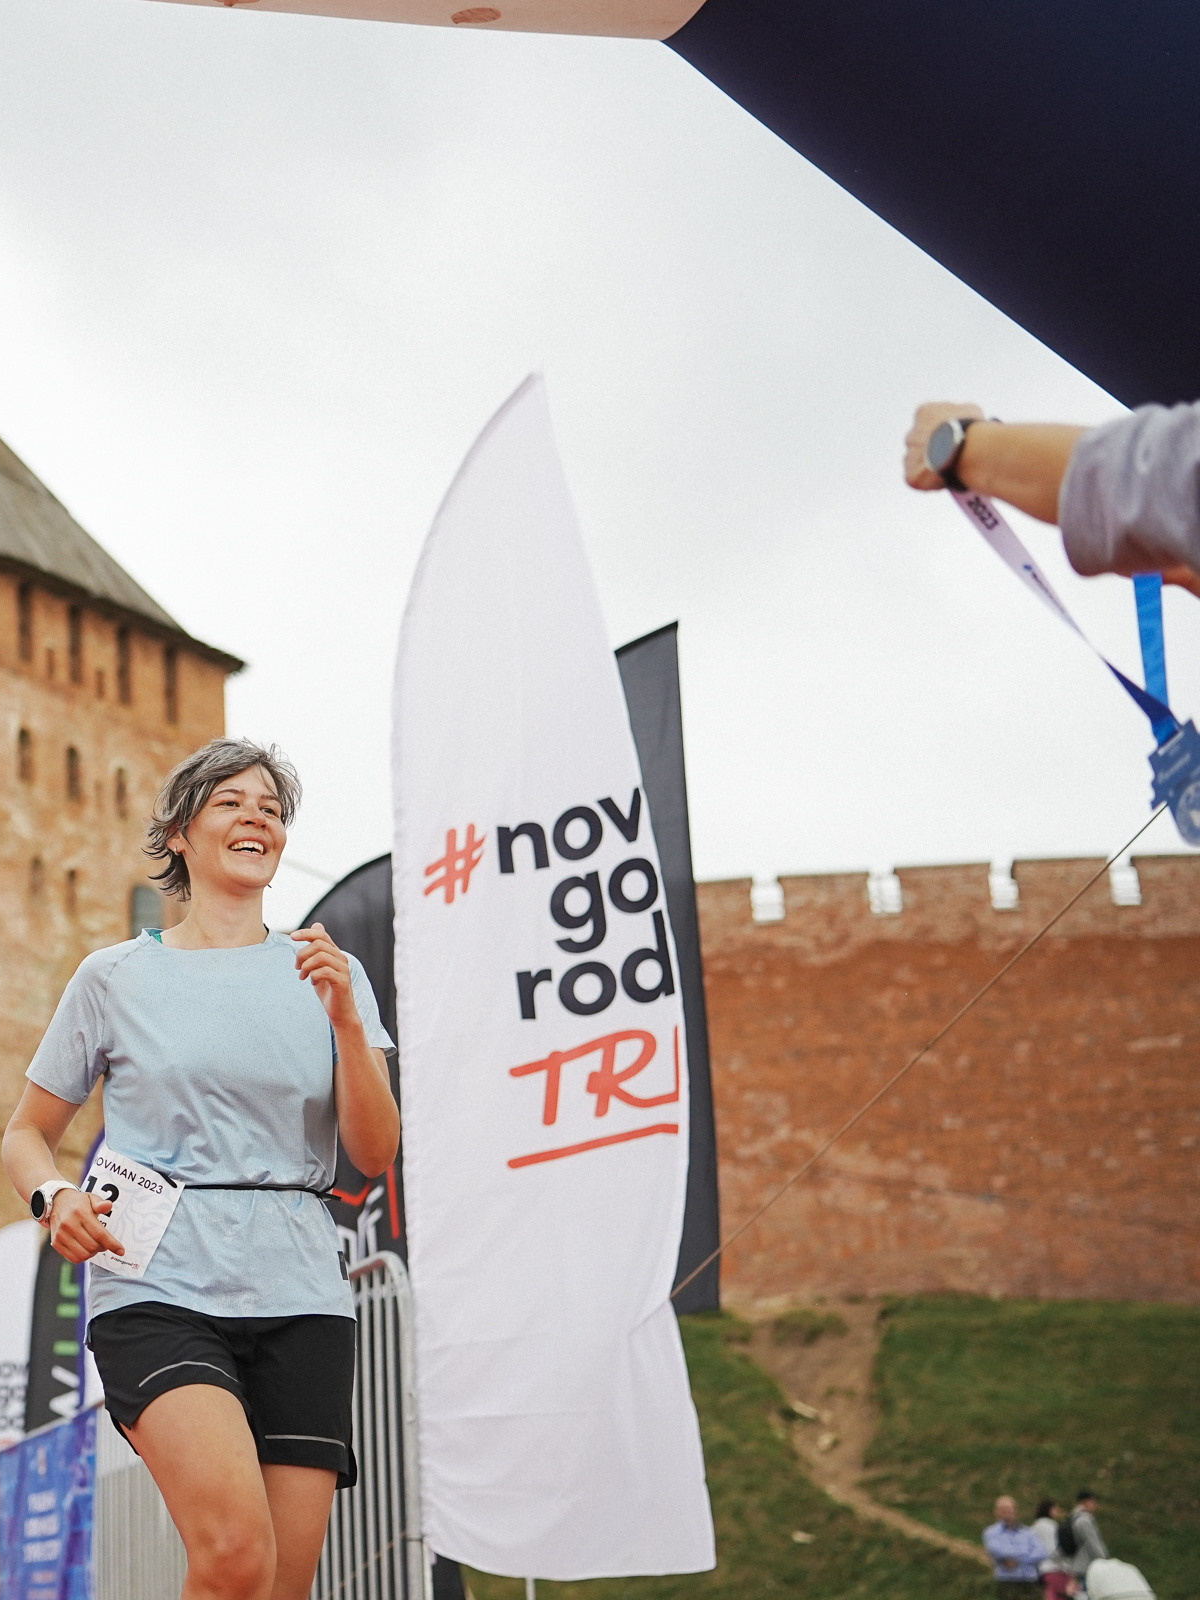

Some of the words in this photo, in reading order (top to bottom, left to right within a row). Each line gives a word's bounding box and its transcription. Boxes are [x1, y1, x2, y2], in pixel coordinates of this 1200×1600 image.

[425, 786, 642, 904] #nov
[550, 857, 659, 954] go
[516, 910, 675, 1020] rod
[94, 1157, 137, 1182] OVMAN
[137, 1176, 164, 1195] 2023
